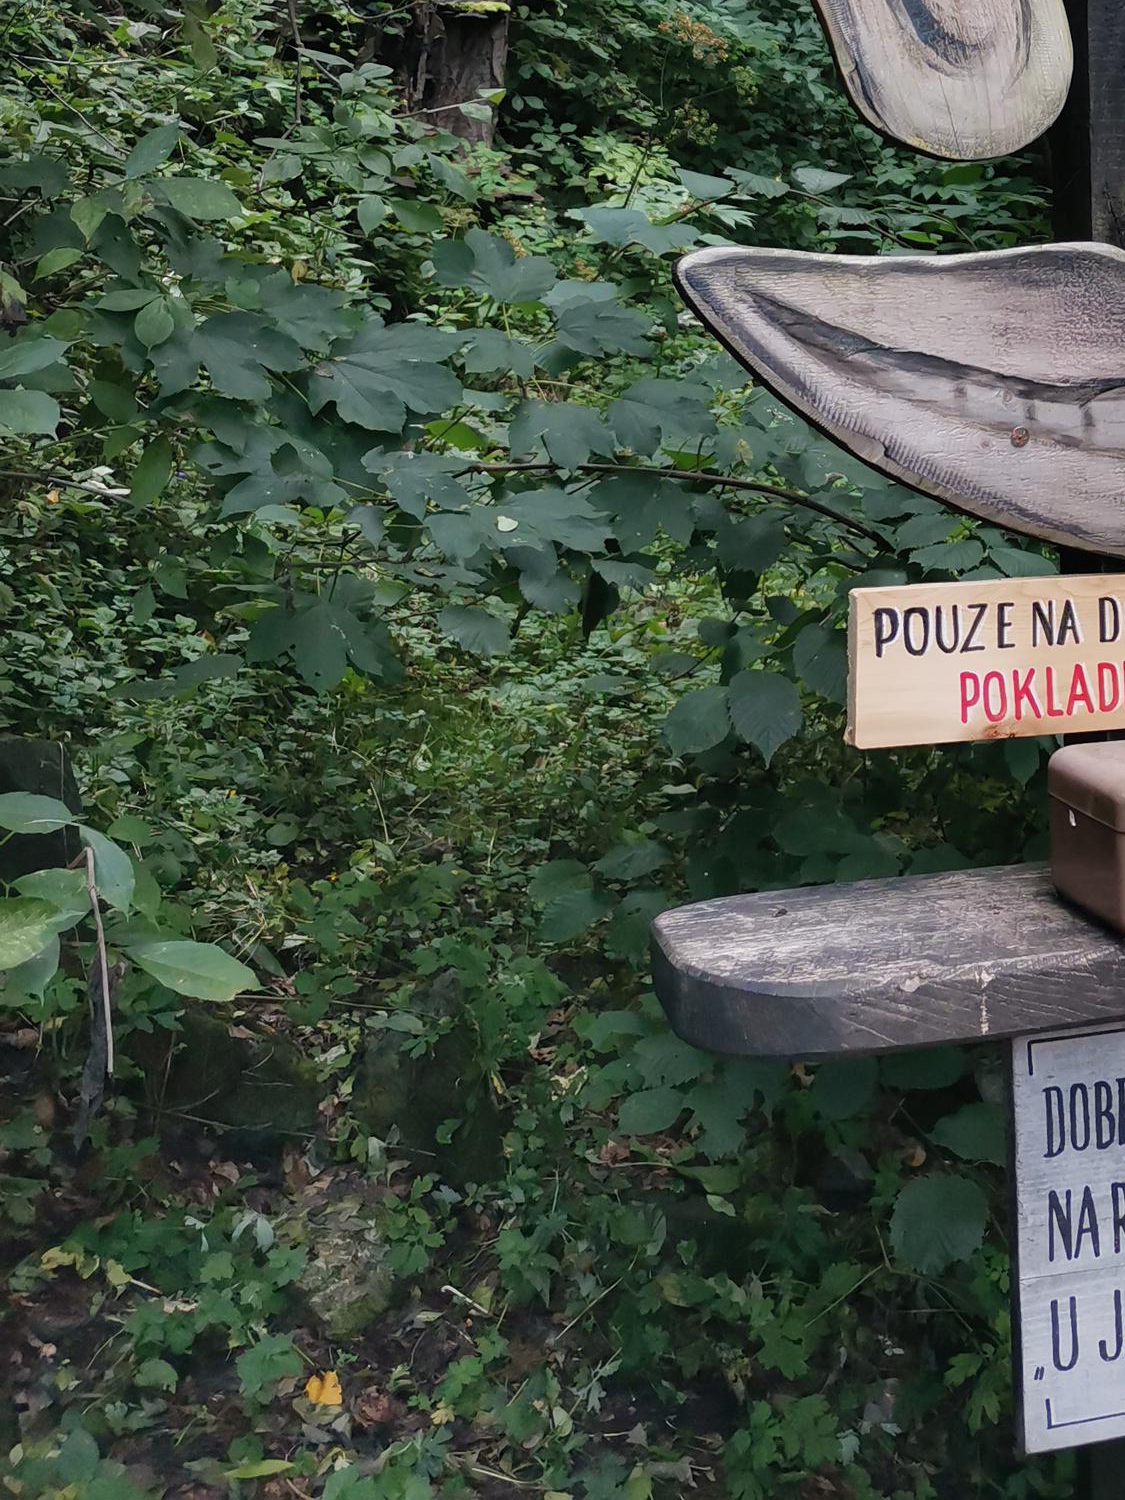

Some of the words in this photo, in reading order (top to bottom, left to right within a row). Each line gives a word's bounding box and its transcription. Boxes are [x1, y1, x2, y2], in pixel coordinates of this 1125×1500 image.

[874, 602, 1015, 658] POUZE
[1032, 599, 1080, 647] NA
[1047, 1188, 1100, 1263] NA
